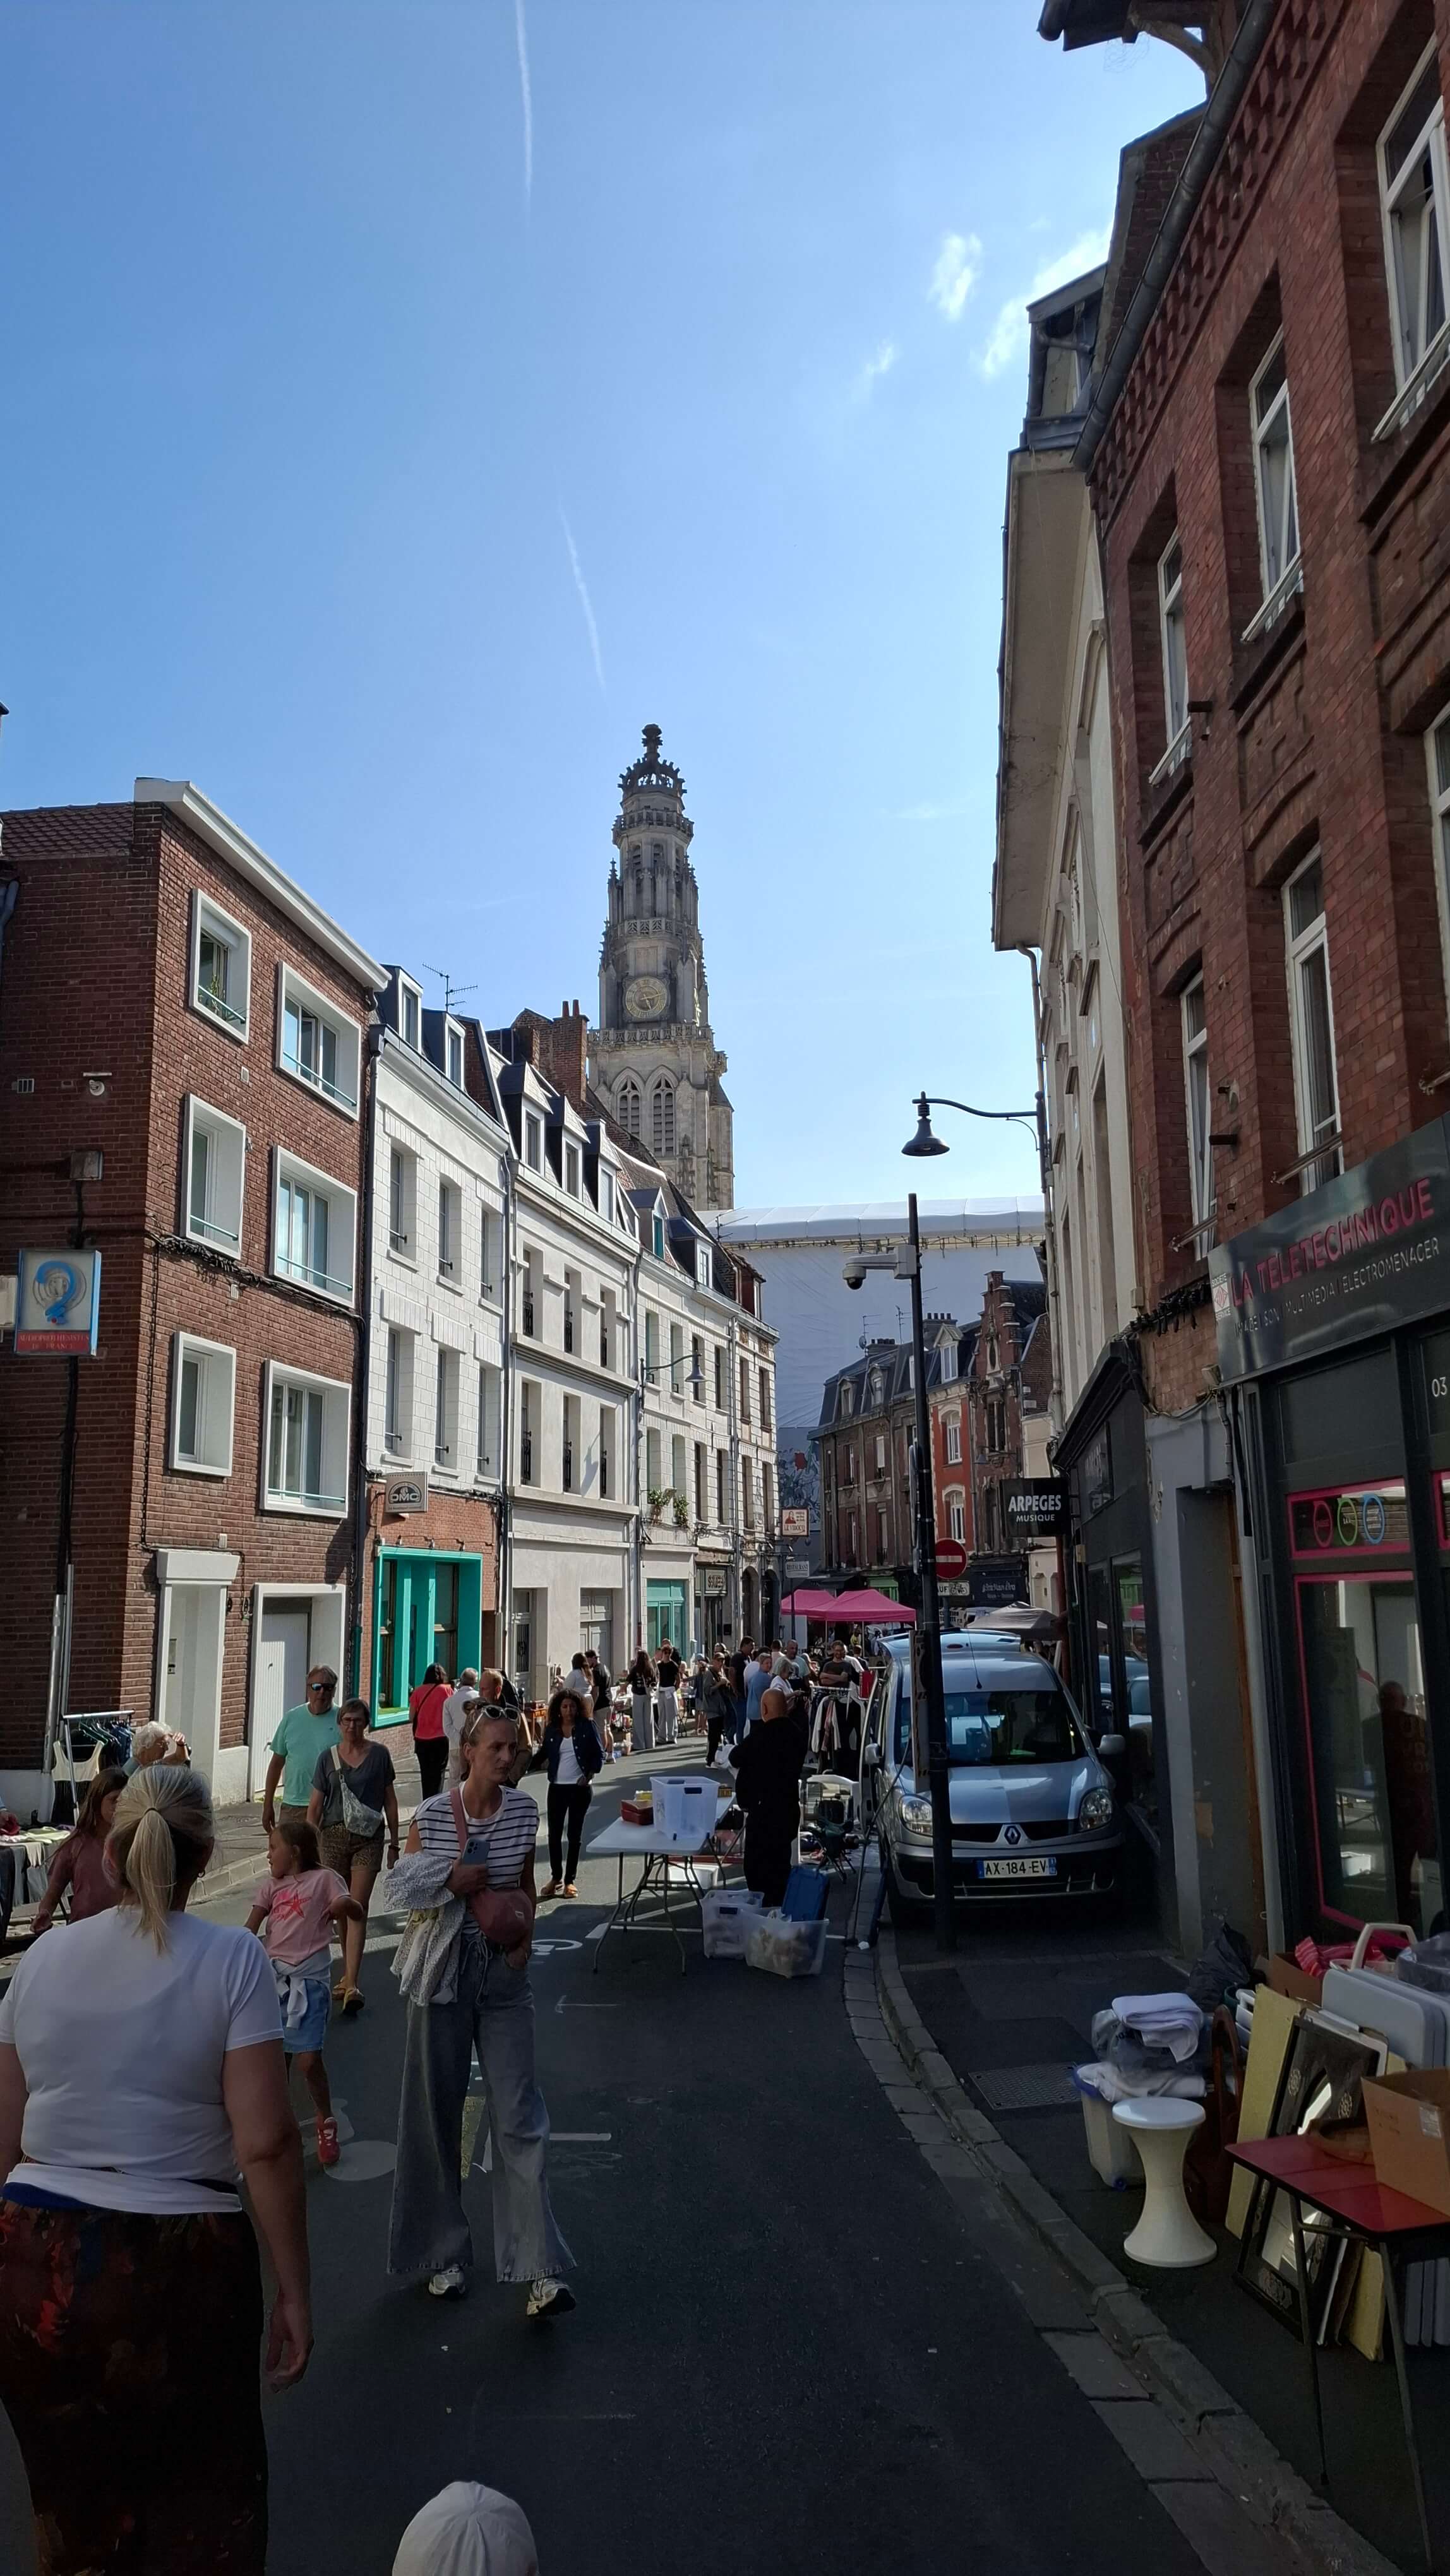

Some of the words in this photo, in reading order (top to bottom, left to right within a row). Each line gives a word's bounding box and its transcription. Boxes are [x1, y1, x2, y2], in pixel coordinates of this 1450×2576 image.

[1231, 1271, 1254, 1308] LA
[1256, 1177, 1434, 1294] TELETECHNIQUE
[1432, 1376, 1447, 1397] 03
[1008, 1494, 1062, 1512] ARPEGES
[1016, 1514, 1055, 1522] MUSIQUE
